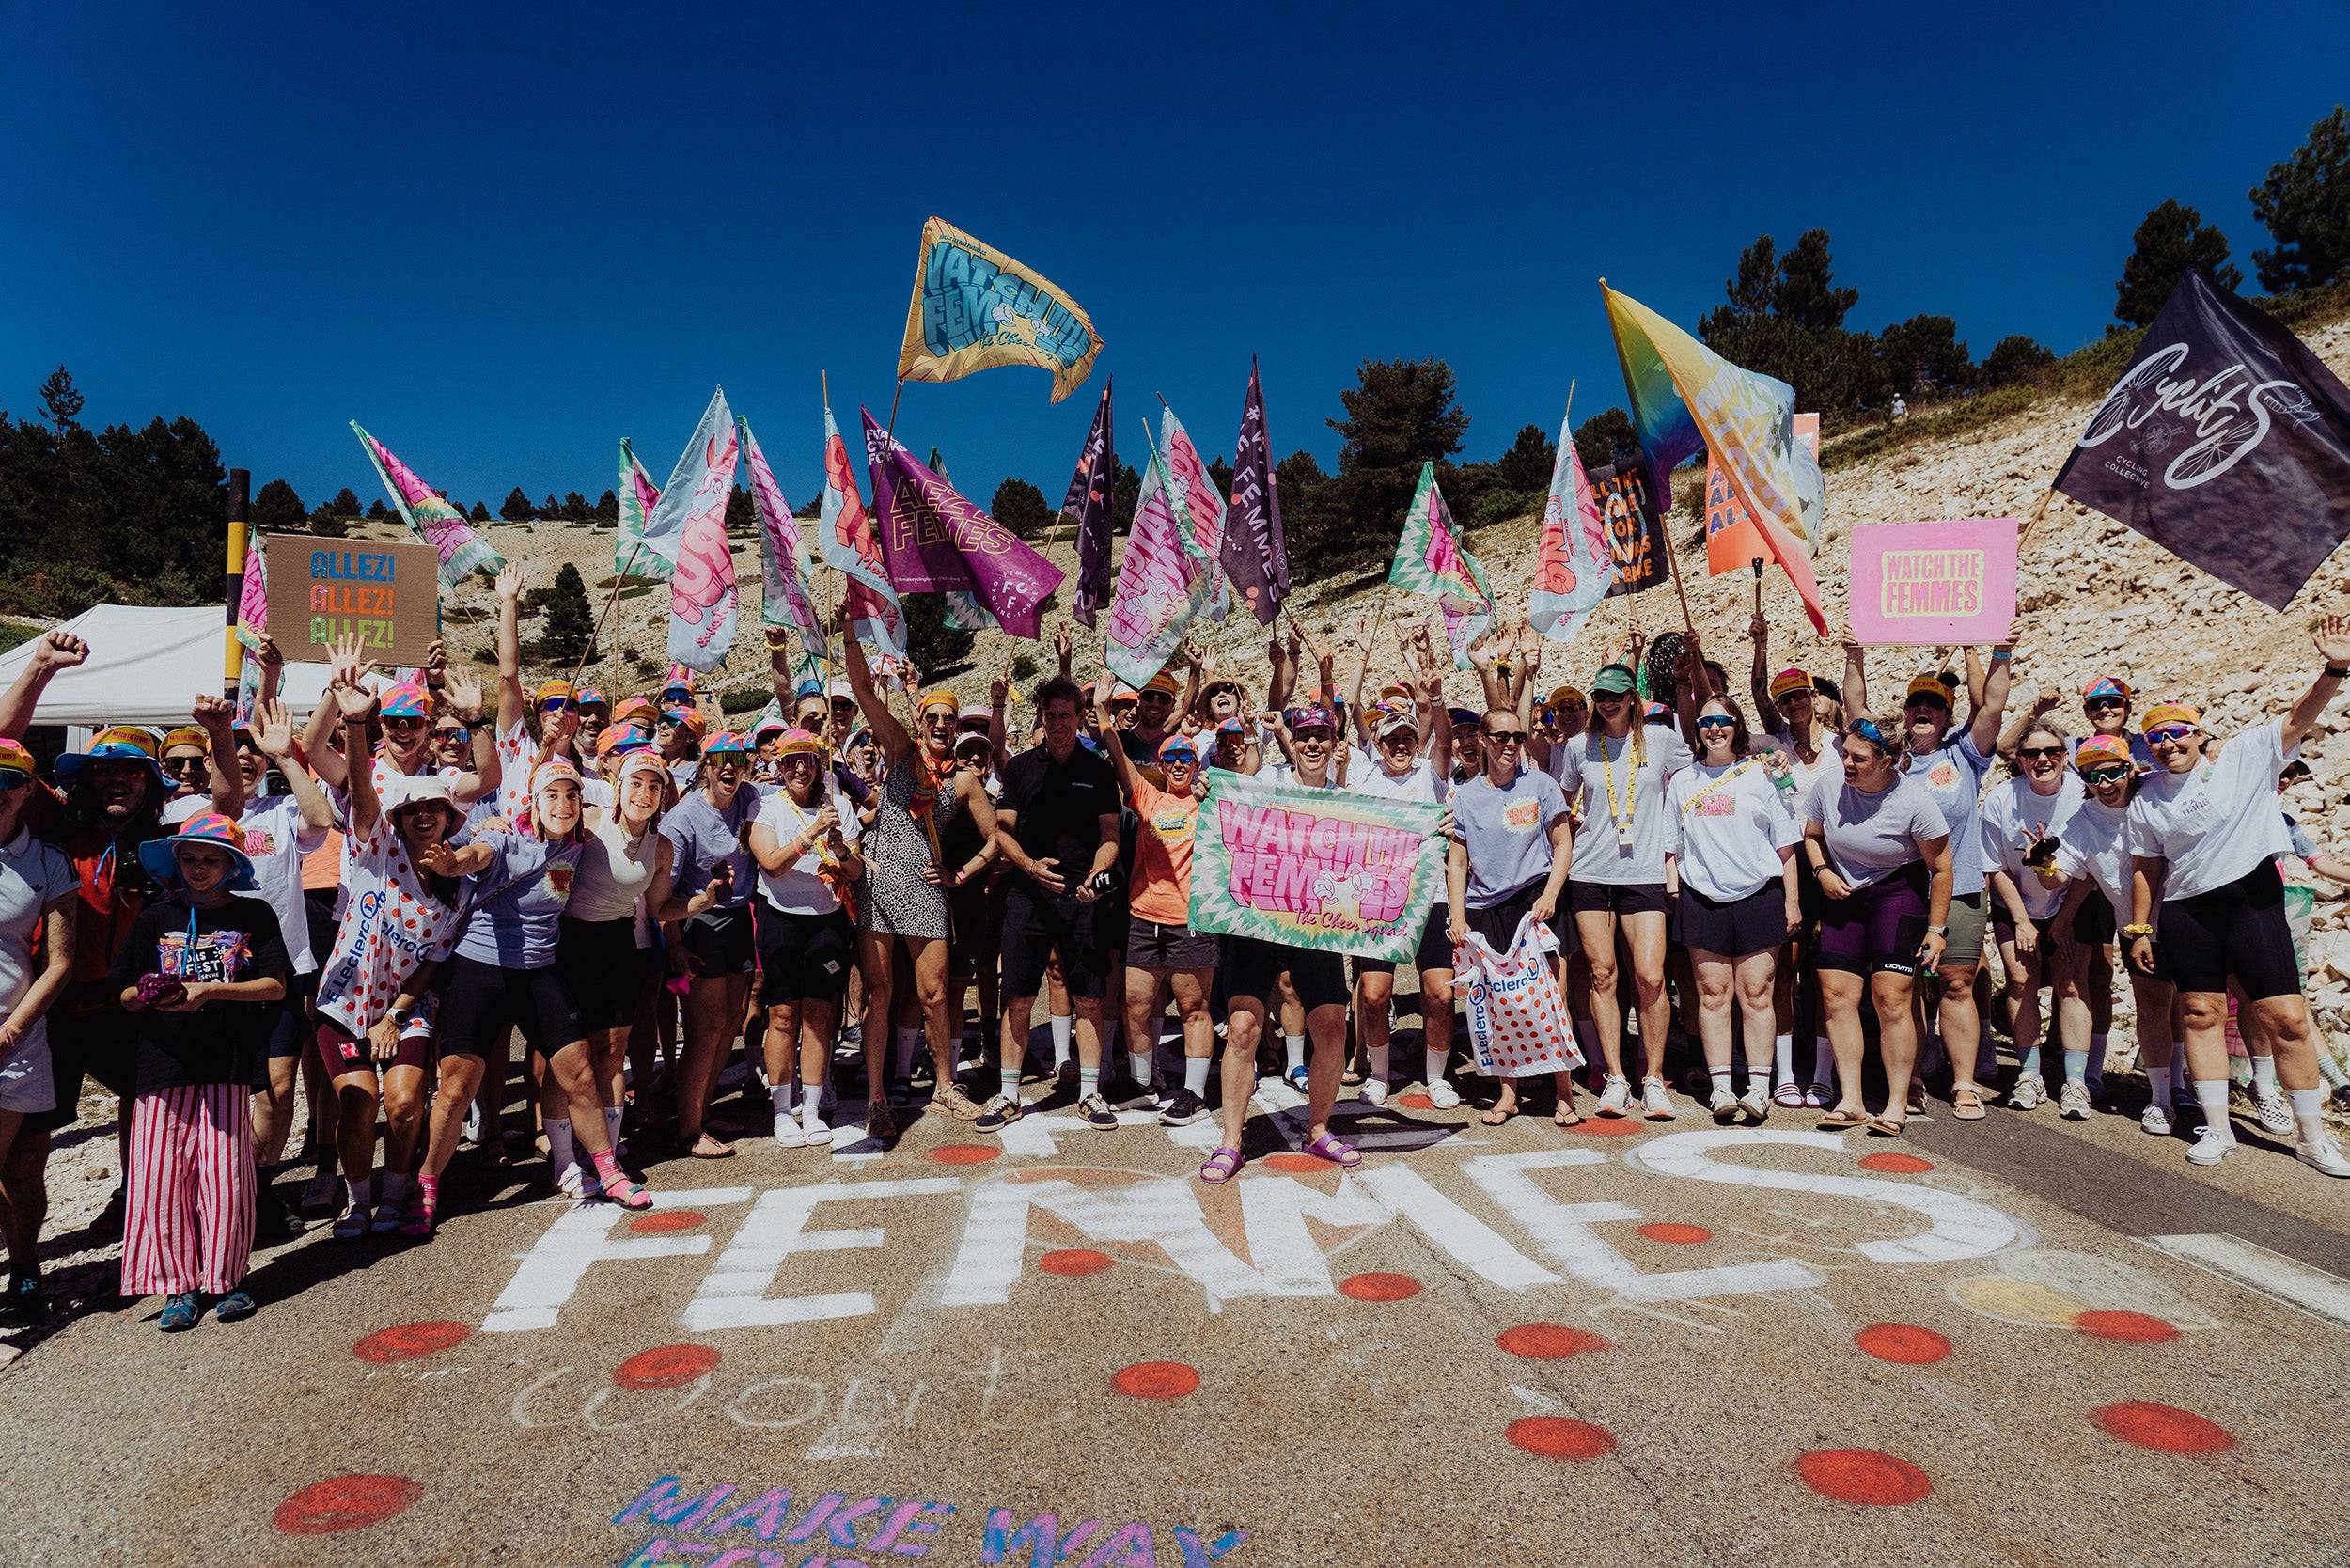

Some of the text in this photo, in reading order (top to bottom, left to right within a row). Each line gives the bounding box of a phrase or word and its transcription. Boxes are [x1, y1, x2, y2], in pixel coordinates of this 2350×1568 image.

[2105, 461, 2150, 489] COLLECTIVE
[2116, 455, 2148, 477] CYCLING
[890, 476, 972, 514] AEZ
[893, 510, 1015, 555] FEES
[1235, 465, 1279, 603] FEMMES
[310, 548, 395, 582] ALLEZ!
[1887, 553, 1979, 580] WATCH THE
[309, 584, 395, 616] ALLEZ!
[992, 580, 1012, 619] CYCLING
[1886, 579, 1979, 613] FEMMES
[310, 617, 395, 648] ALLEZ!
[1218, 799, 1423, 871] WATCH THE
[1296, 908, 1408, 941] The Cheer Squad
[186, 960, 221, 976] FEST
[327, 918, 370, 1004] E.Leclerc
[1884, 962, 1914, 974] CIOVITA
[1474, 1005, 1495, 1067] E.Leclerc
[482, 1128, 2018, 1332] FEMMES
[612, 1476, 1250, 1568] MAKE WAY
